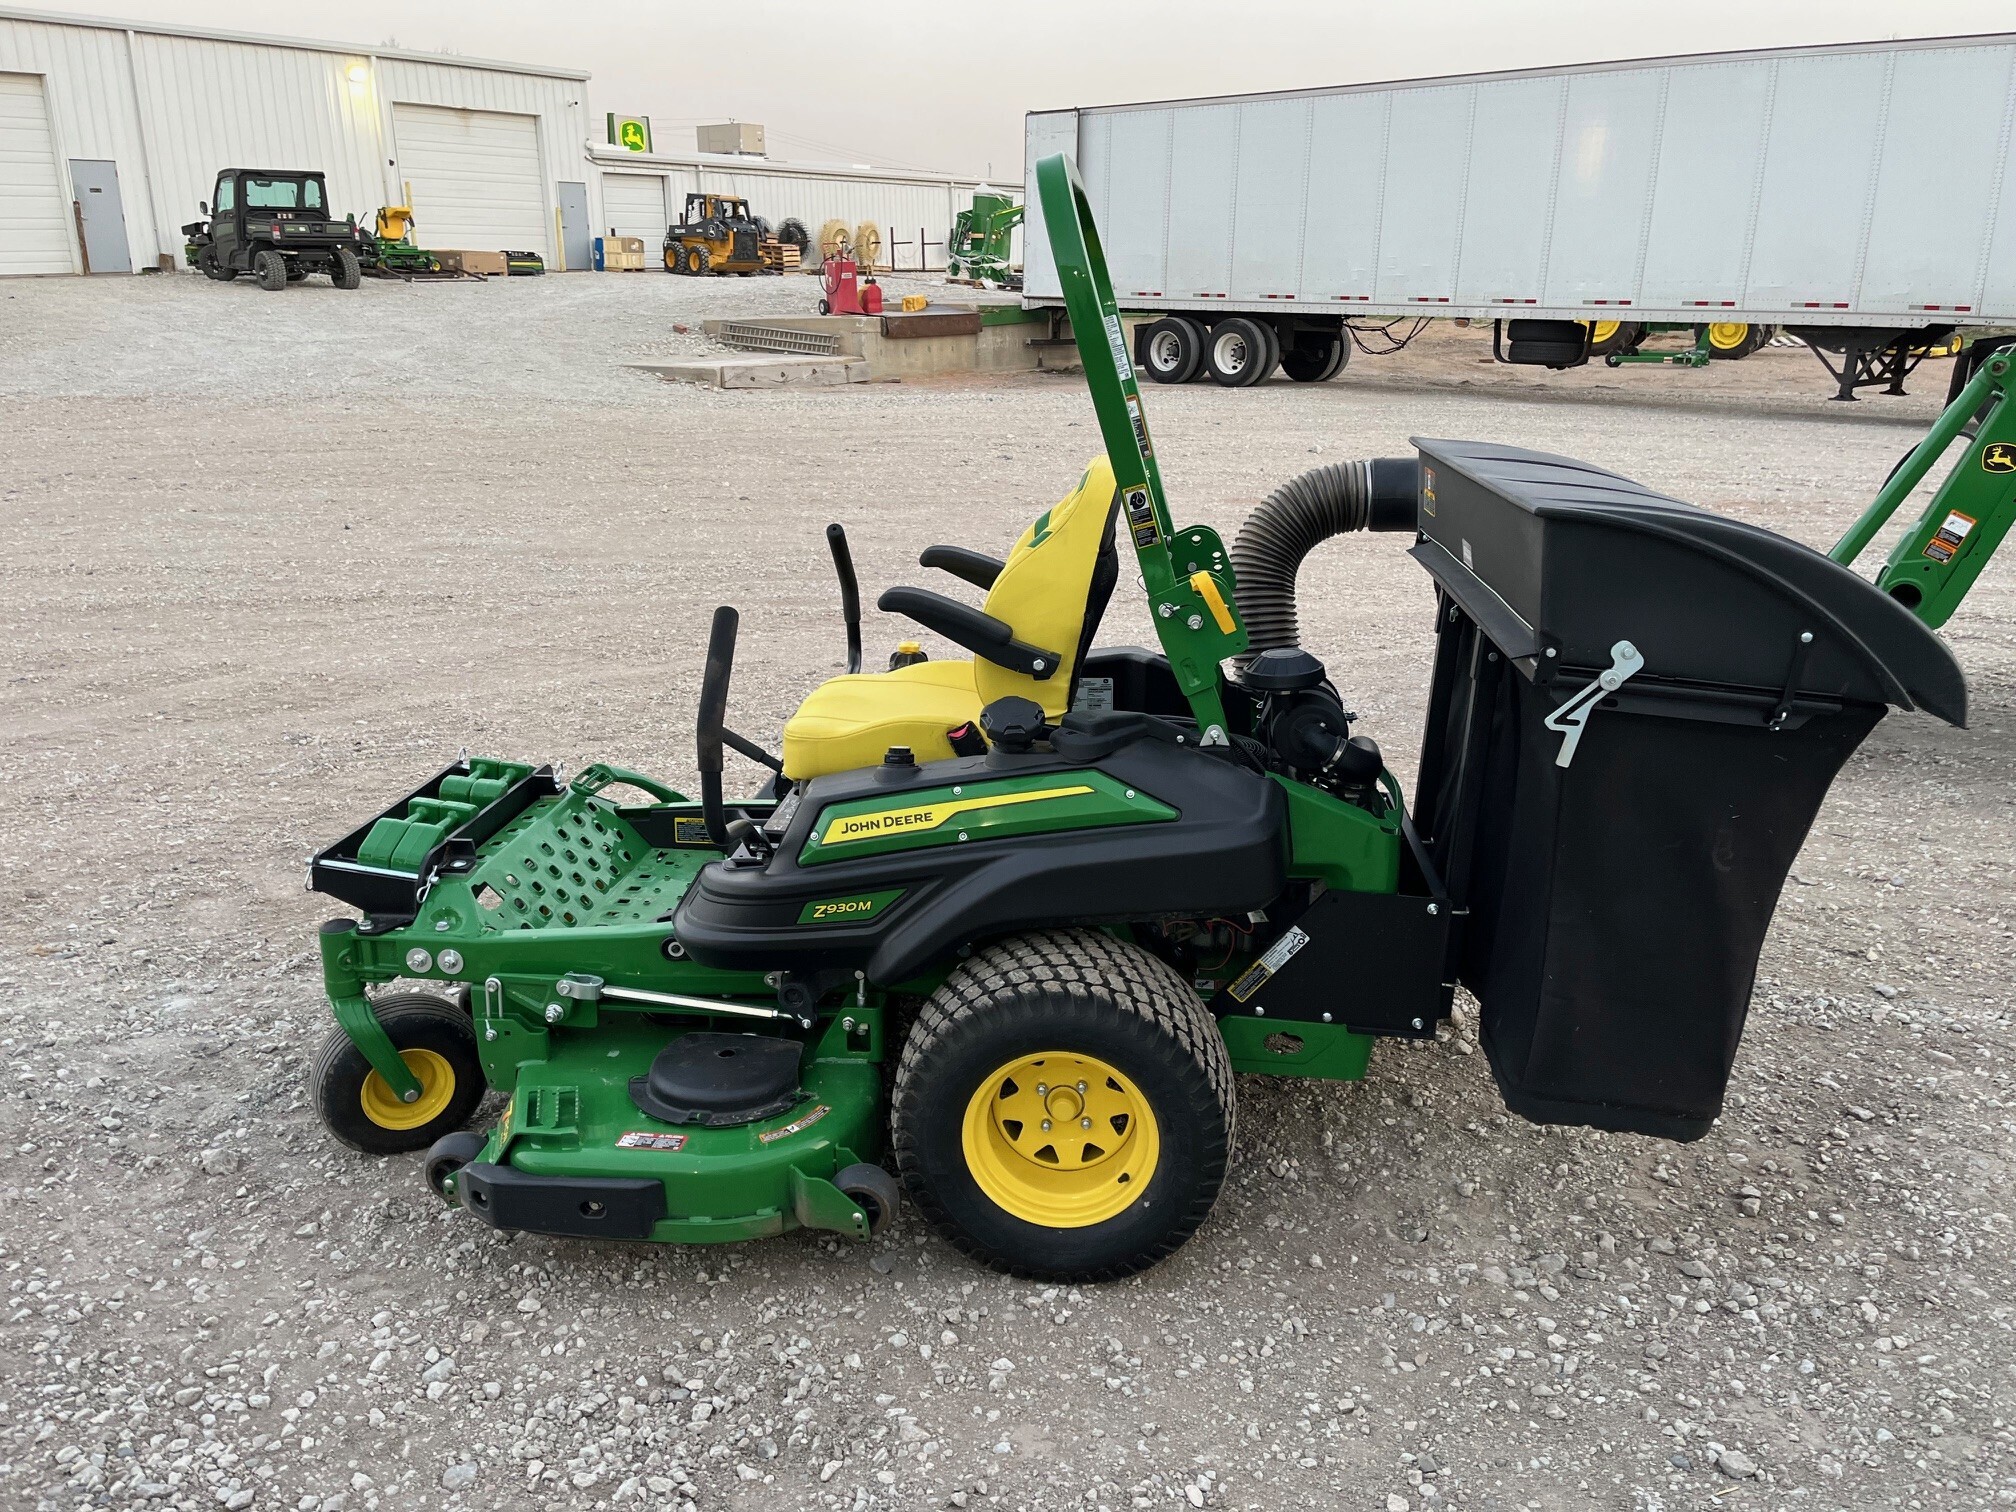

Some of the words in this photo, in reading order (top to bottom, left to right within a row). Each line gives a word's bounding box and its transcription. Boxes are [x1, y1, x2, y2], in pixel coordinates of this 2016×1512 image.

[841, 819, 881, 835] JOHN
[883, 811, 933, 828] DEERE
[813, 900, 872, 919] Z930M
